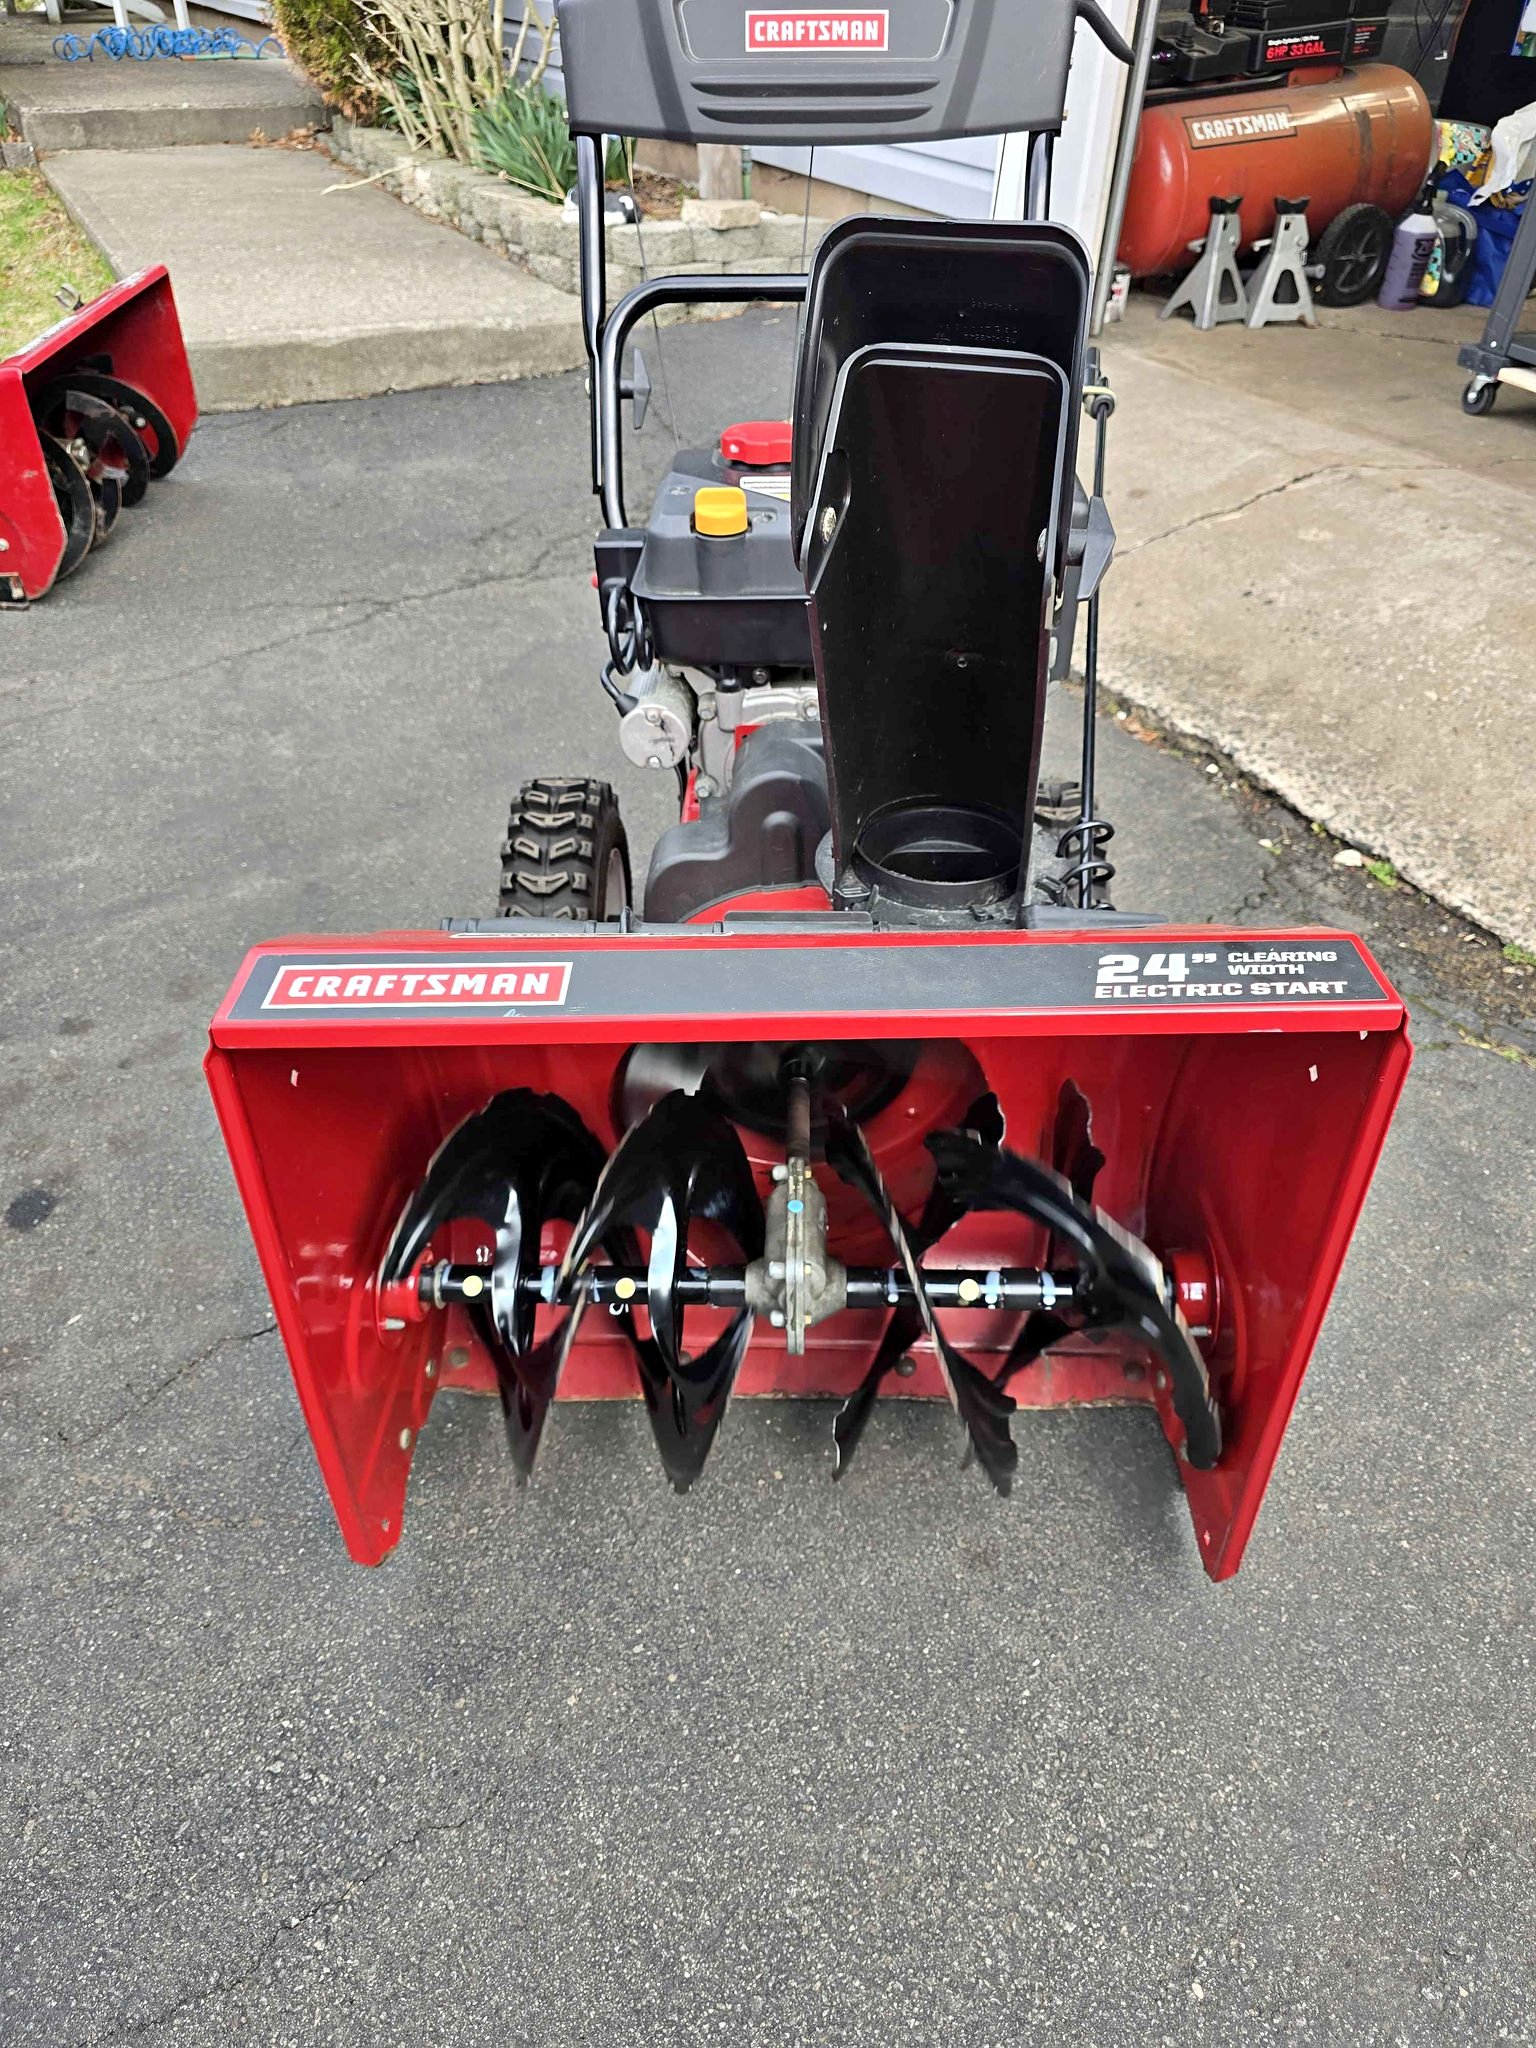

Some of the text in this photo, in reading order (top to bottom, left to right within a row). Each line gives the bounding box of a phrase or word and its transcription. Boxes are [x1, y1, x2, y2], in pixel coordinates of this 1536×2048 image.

[754, 19, 879, 42] CRAFTSMAN
[1191, 111, 1290, 141] CRAFTSMAN
[1227, 951, 1338, 963] CLEARING
[1227, 964, 1305, 976] WIDTH
[287, 973, 550, 998] CRAFTSMAN
[1094, 980, 1348, 999] ELECTRIC START
